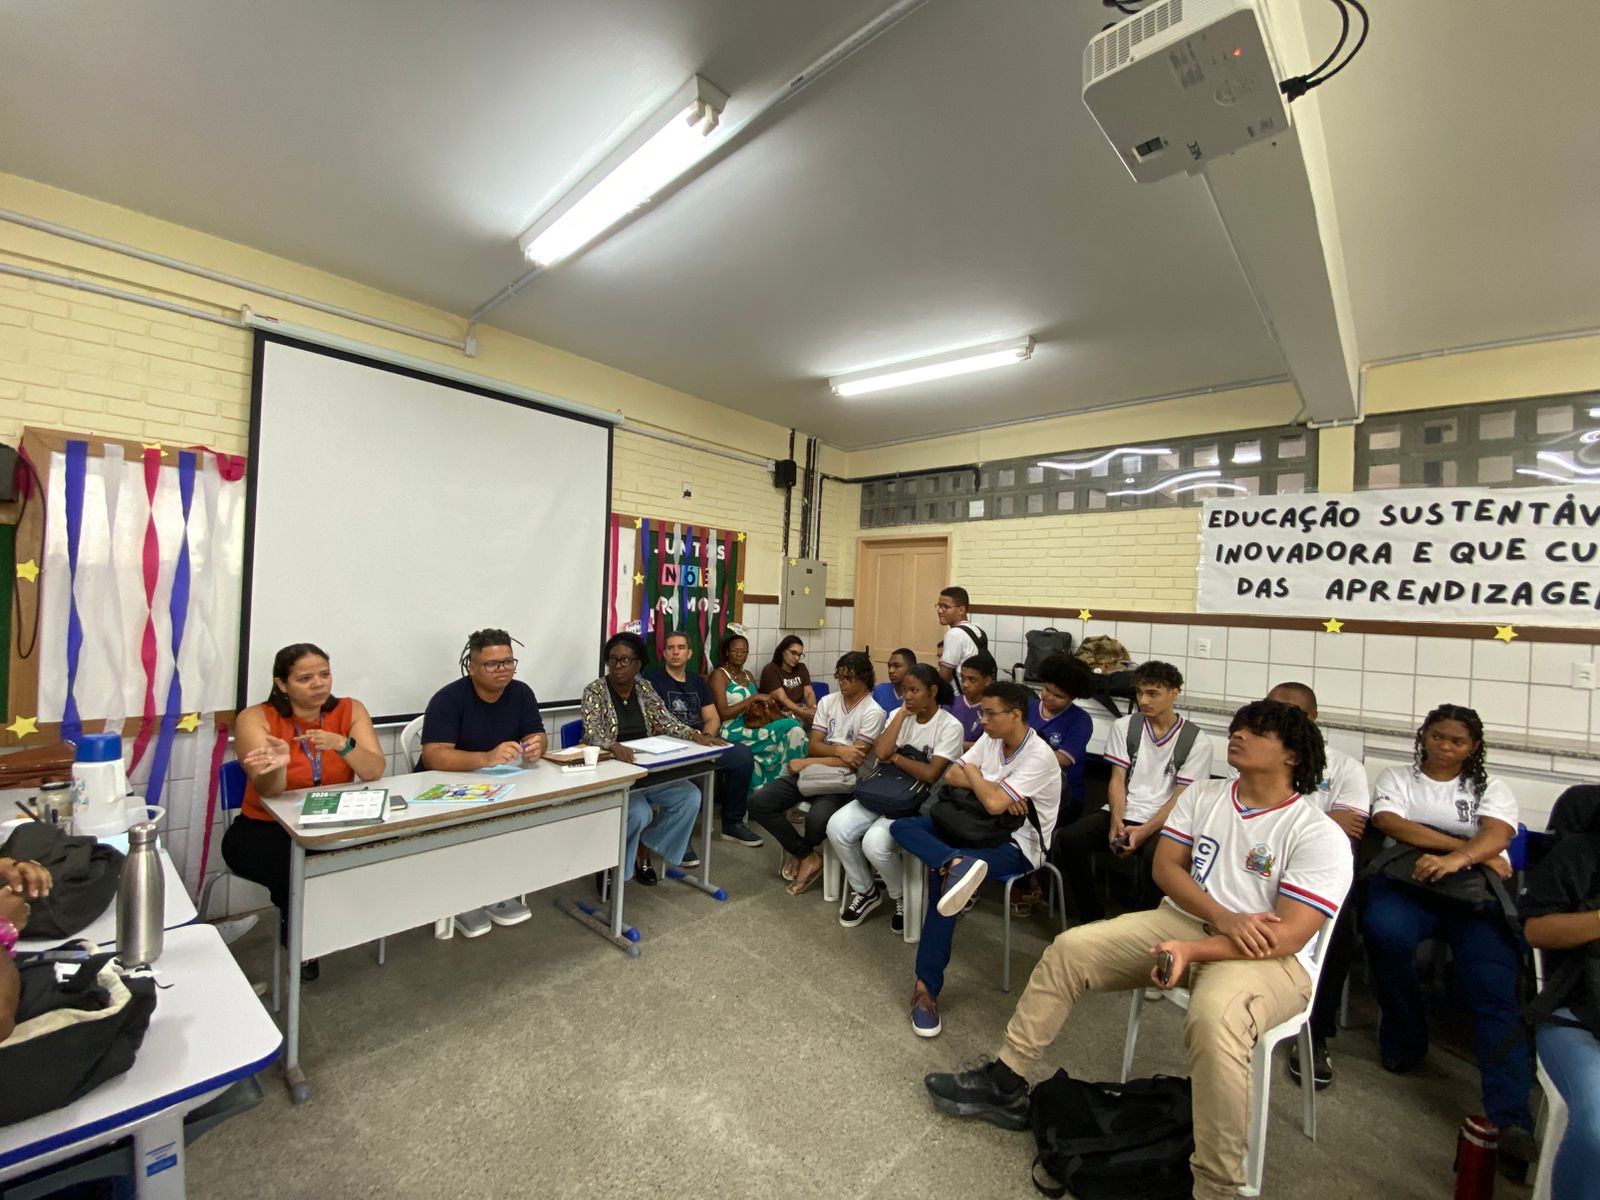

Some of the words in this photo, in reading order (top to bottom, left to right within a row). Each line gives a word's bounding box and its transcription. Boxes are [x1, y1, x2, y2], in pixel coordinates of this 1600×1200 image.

[1208, 500, 1361, 534] EDUCAÇÃO
[1379, 493, 1600, 527] SUSTENTÁV
[1215, 540, 1392, 566] INOVADORA
[1412, 541, 1433, 563] E
[1449, 537, 1526, 565] QUE
[1237, 577, 1289, 599] DAS
[1325, 578, 1600, 610] APRENDIZAGE
